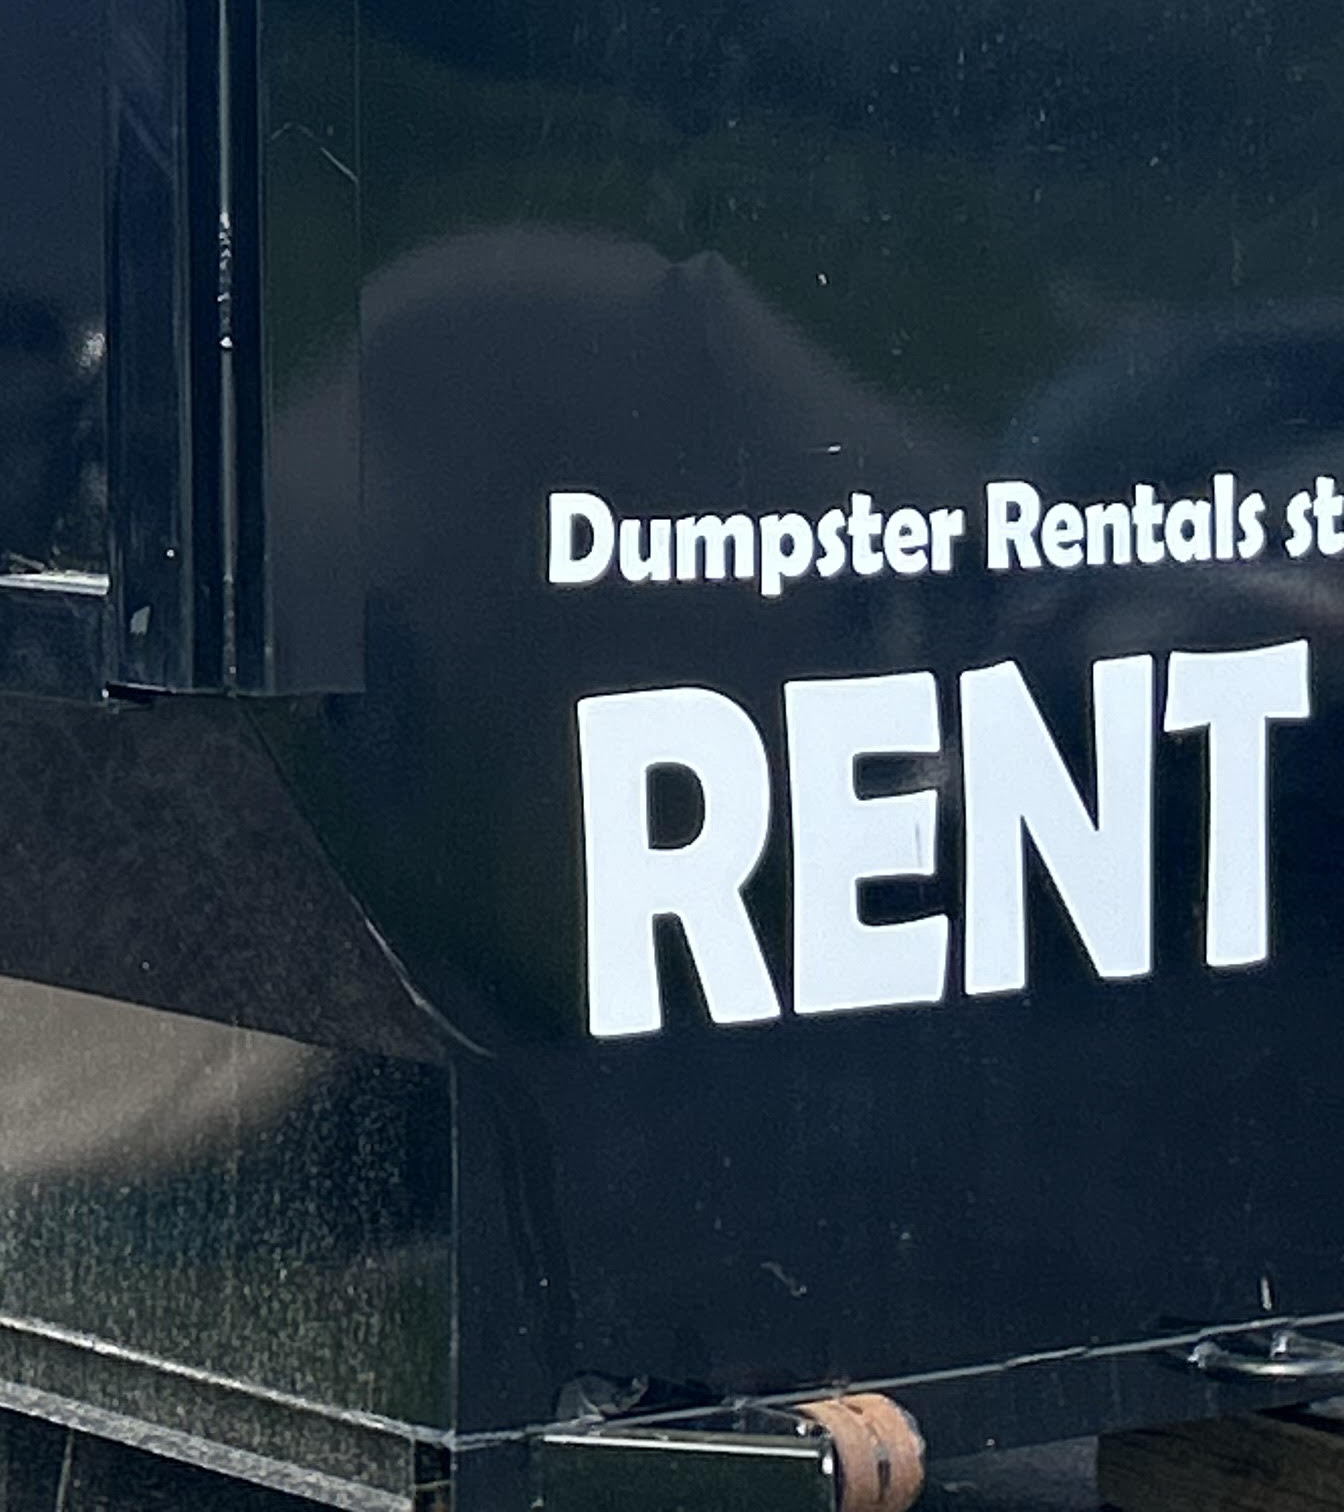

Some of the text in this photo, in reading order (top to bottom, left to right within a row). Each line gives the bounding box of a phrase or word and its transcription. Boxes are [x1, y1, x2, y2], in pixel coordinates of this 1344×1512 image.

[548, 473, 1344, 596] Dumpster Rentals st
[577, 639, 1311, 1037] RENT
